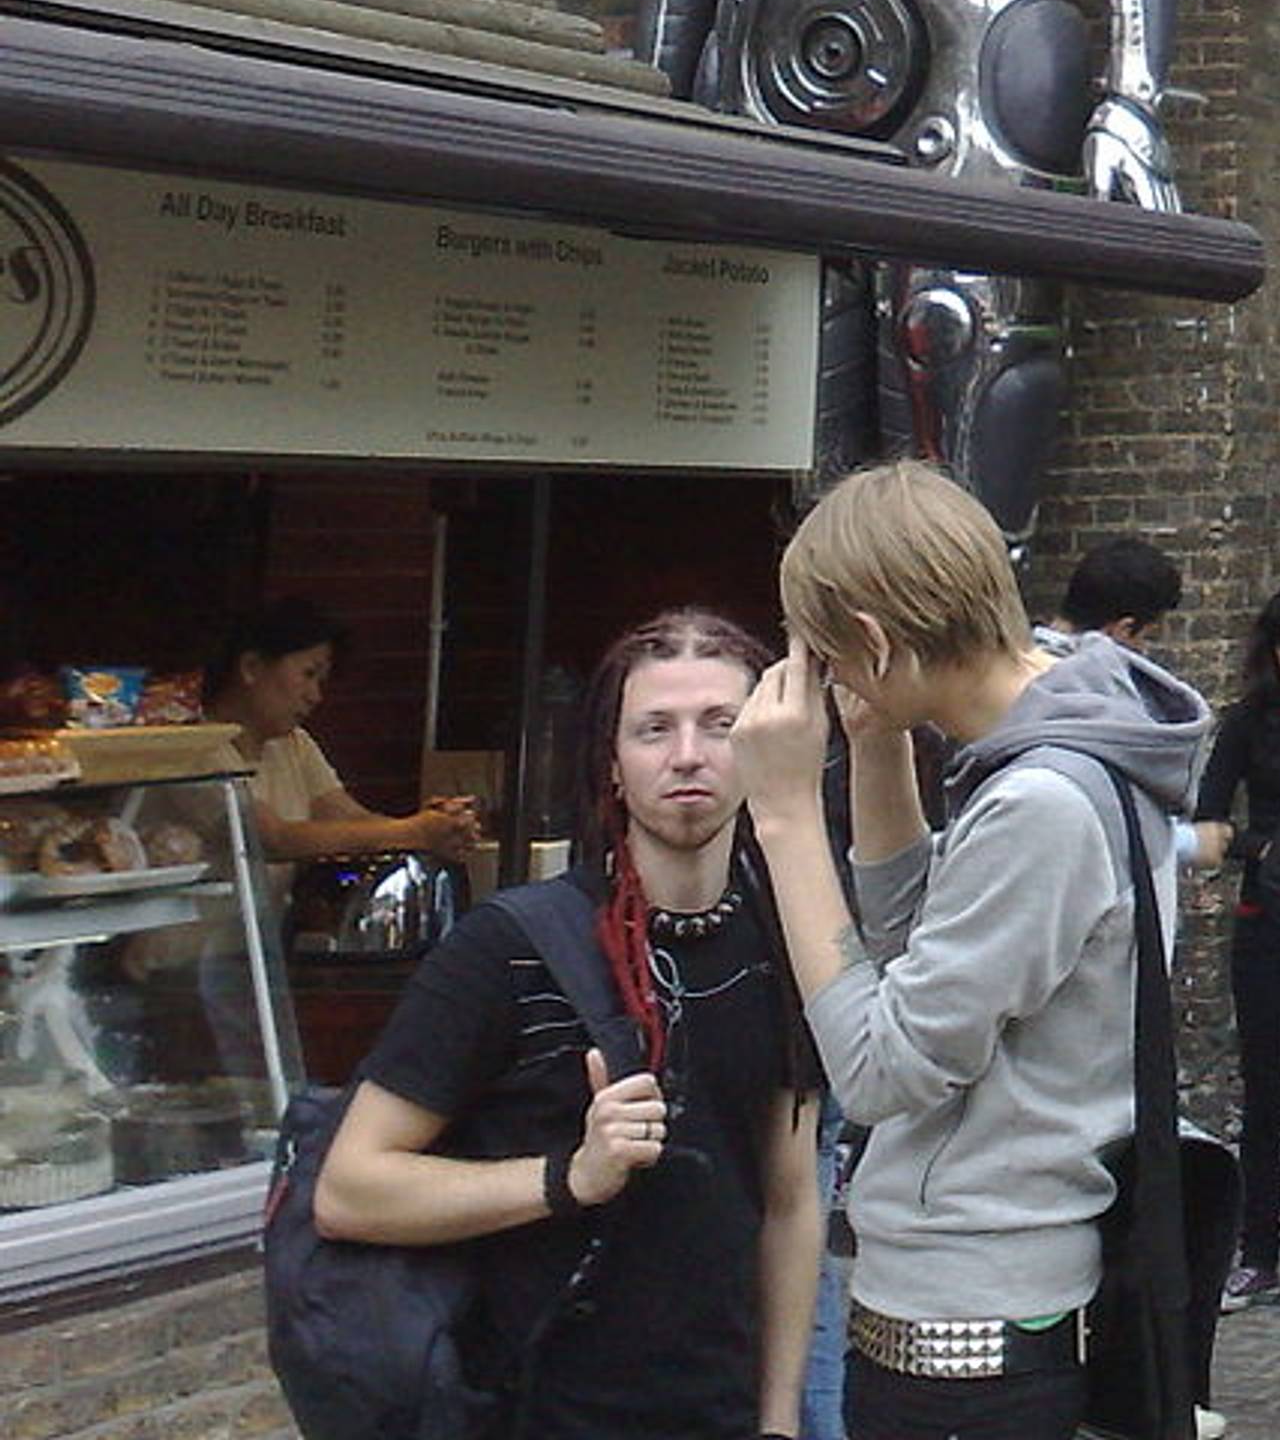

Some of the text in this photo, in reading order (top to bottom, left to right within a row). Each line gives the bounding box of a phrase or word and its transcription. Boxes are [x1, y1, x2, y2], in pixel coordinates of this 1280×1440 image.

[159, 192, 346, 238] All Day Breakfast
[436, 225, 511, 258] Burgers
